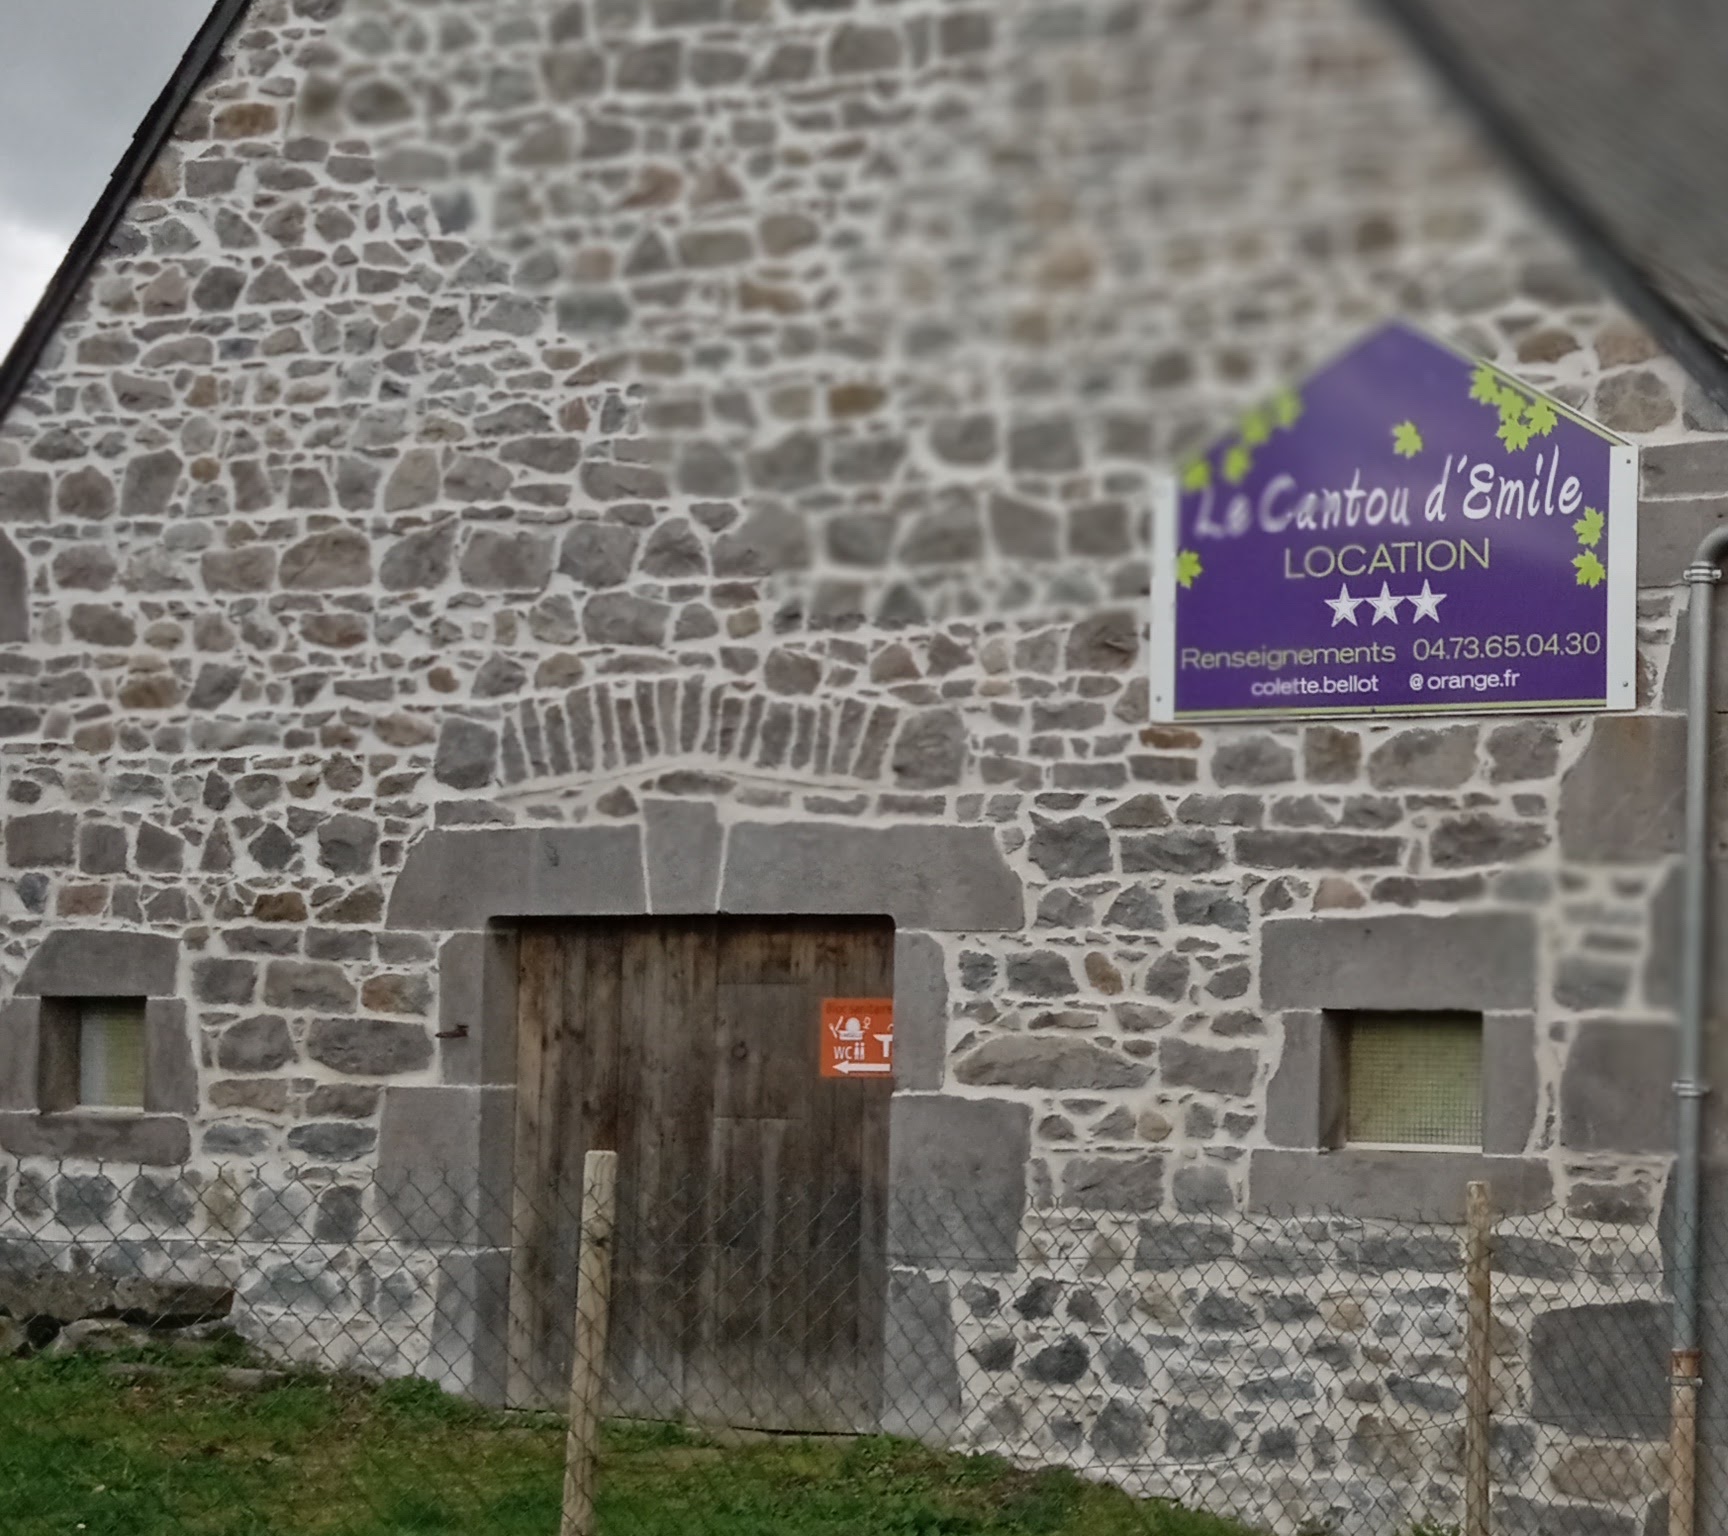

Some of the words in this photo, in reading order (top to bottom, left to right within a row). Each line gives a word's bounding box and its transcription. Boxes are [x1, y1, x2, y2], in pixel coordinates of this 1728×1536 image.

[1195, 486, 1250, 538] Le
[1258, 468, 1411, 532] Cantou
[1424, 443, 1583, 523] d'Emile
[1284, 537, 1490, 579] LOCATION
[1181, 642, 1396, 671] Renseignements
[1412, 631, 1601, 662] 04.73.65.04.30
[1251, 674, 1380, 697] colette.bellot
[833, 1045, 853, 1060] WC
